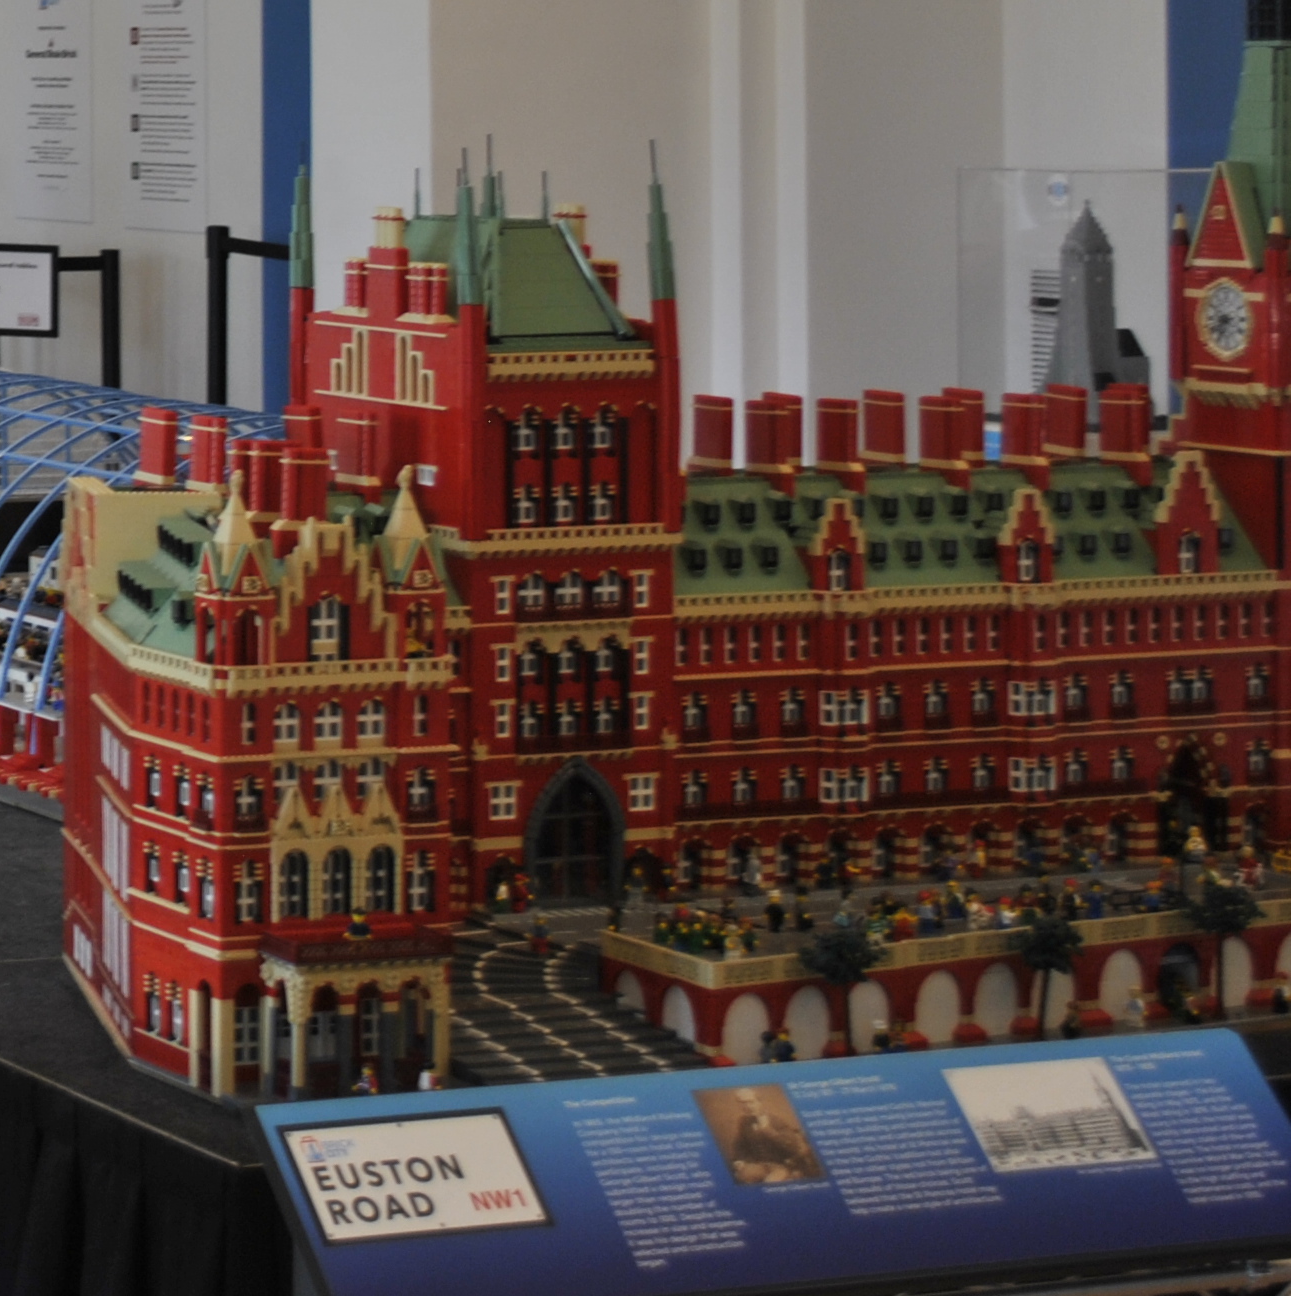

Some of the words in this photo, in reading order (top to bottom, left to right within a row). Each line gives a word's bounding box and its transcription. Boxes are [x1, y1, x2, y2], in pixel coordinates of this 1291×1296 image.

[311, 1153, 465, 1192] EUSTON
[326, 1191, 435, 1226] ROAD
[469, 1188, 529, 1212] NW1
